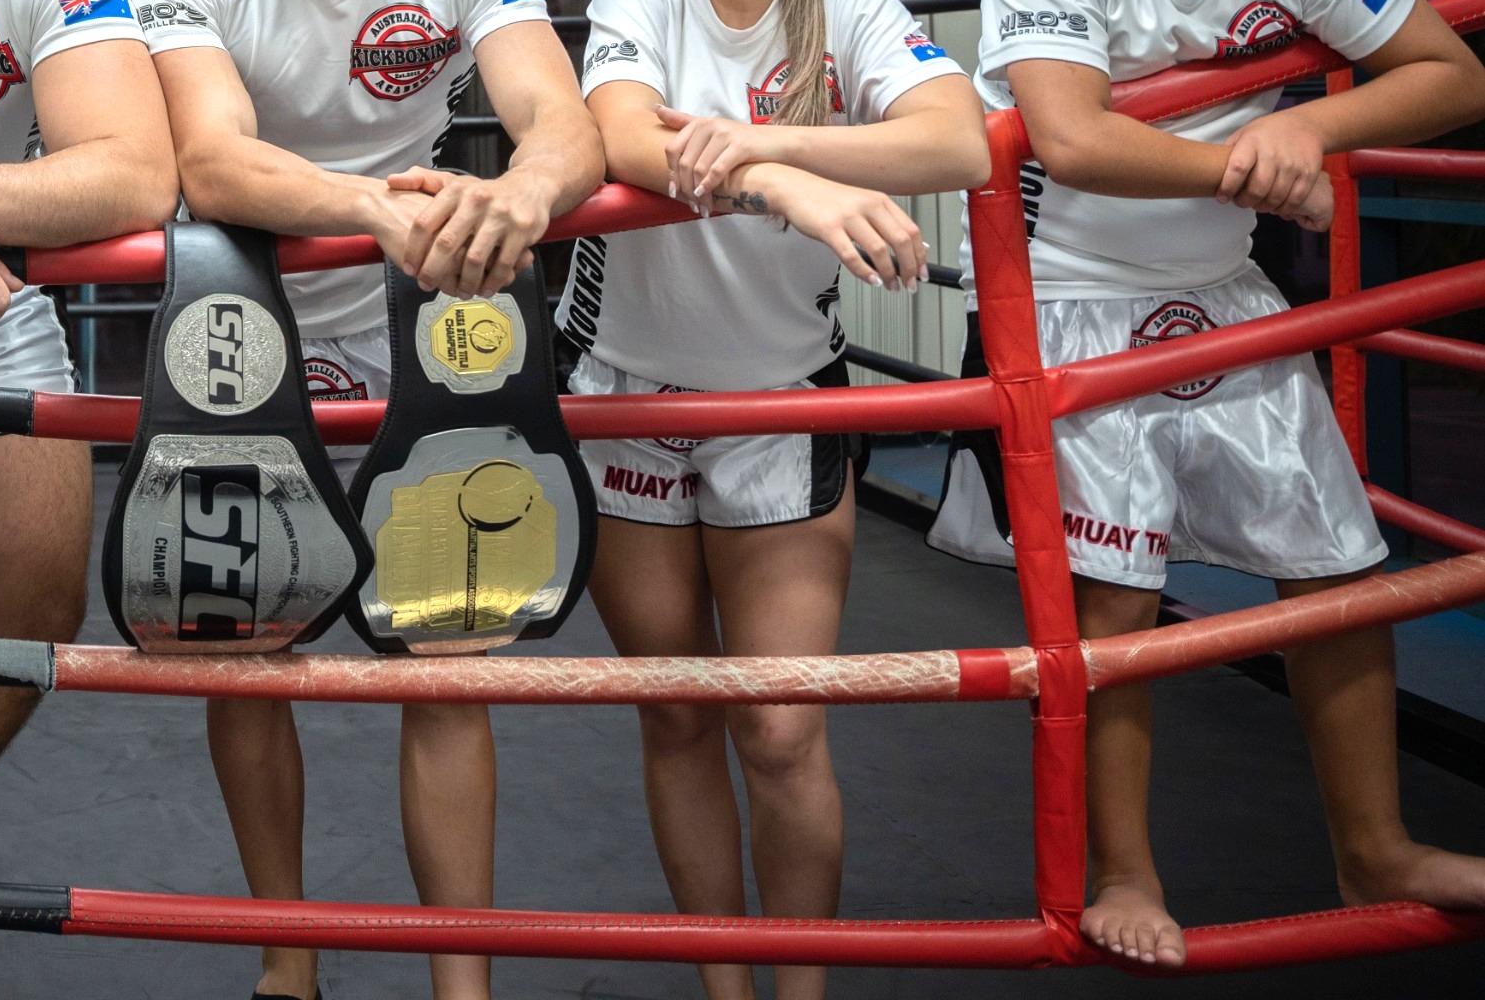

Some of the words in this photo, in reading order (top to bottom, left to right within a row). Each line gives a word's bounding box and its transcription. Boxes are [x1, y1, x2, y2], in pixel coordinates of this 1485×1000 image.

[370, 12, 434, 38] AUSTRALIAN
[208, 306, 243, 403] SFC
[603, 465, 677, 501] MUAY
[182, 472, 259, 638] SFC
[271, 496, 296, 539] SOUTHERN
[288, 540, 300, 576] FIGHTING
[1063, 512, 1141, 553] MUAY
[152, 537, 168, 596] CHAMPION
